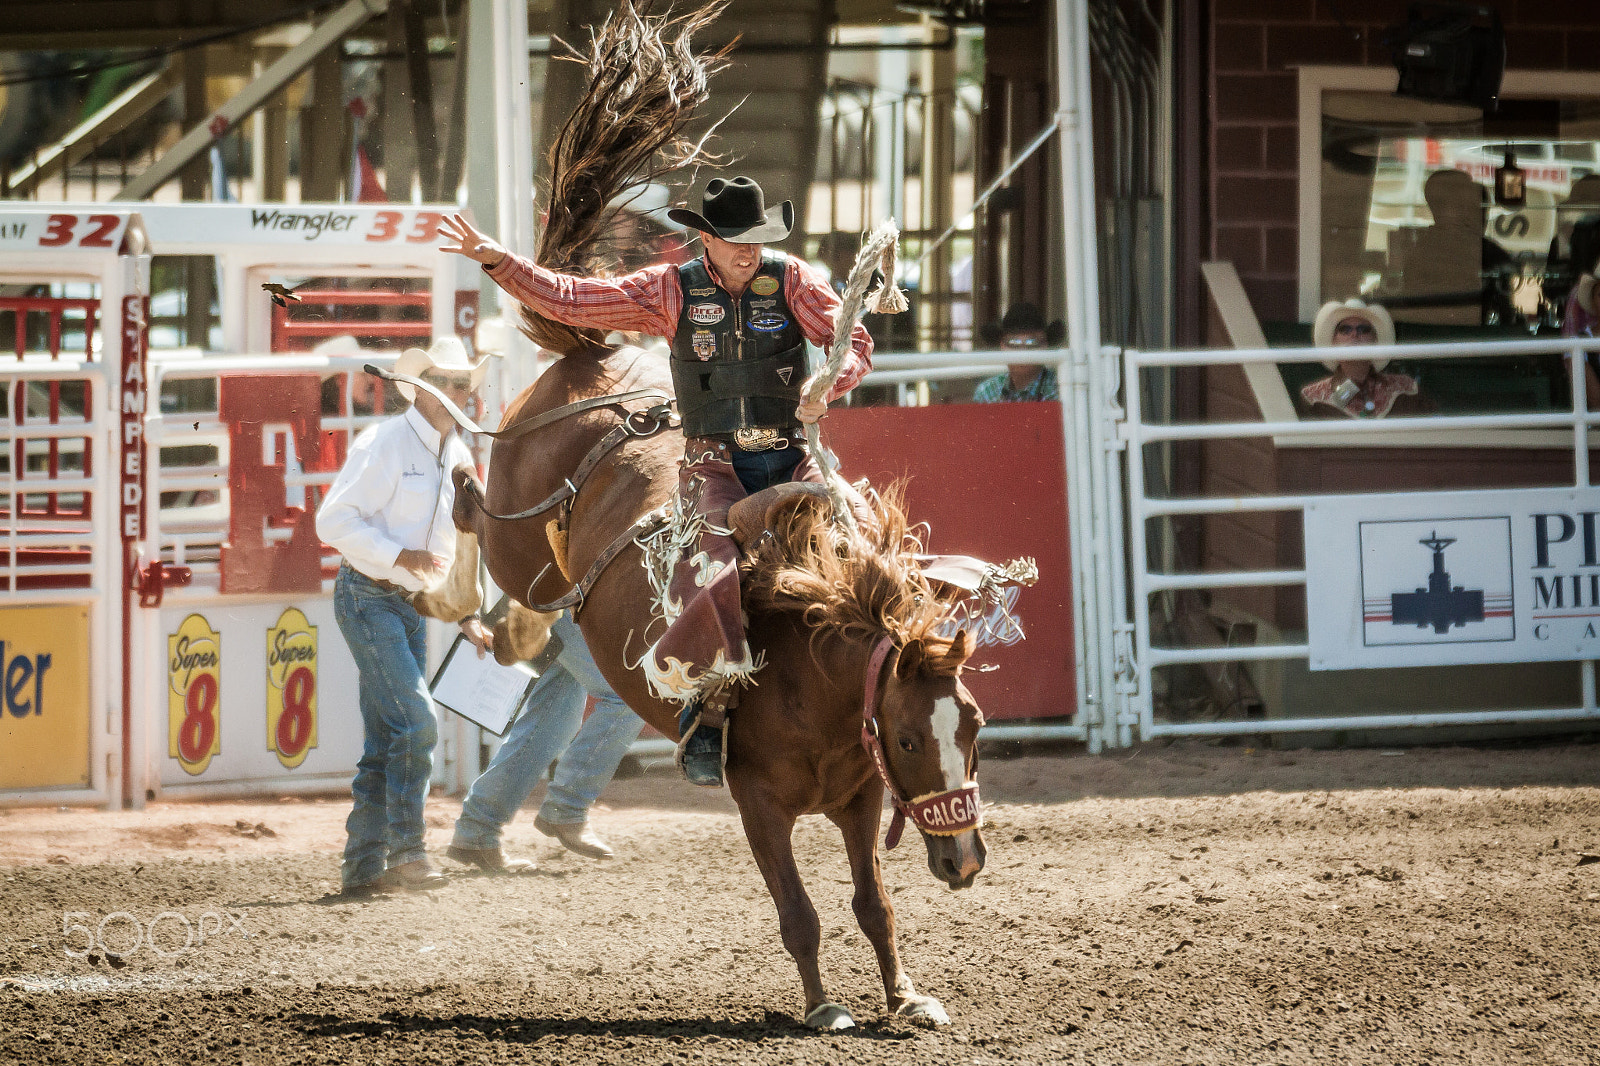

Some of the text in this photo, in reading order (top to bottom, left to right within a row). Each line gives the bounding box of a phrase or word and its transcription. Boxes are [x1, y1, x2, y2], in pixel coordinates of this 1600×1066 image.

[38, 213, 121, 248] 32
[250, 208, 444, 243] Wrangler 33
[122, 299, 146, 537] STAMPEDE
[171, 636, 219, 690] Super
[269, 629, 318, 684] Super
[178, 673, 218, 763] 8
[276, 666, 315, 757] 8
